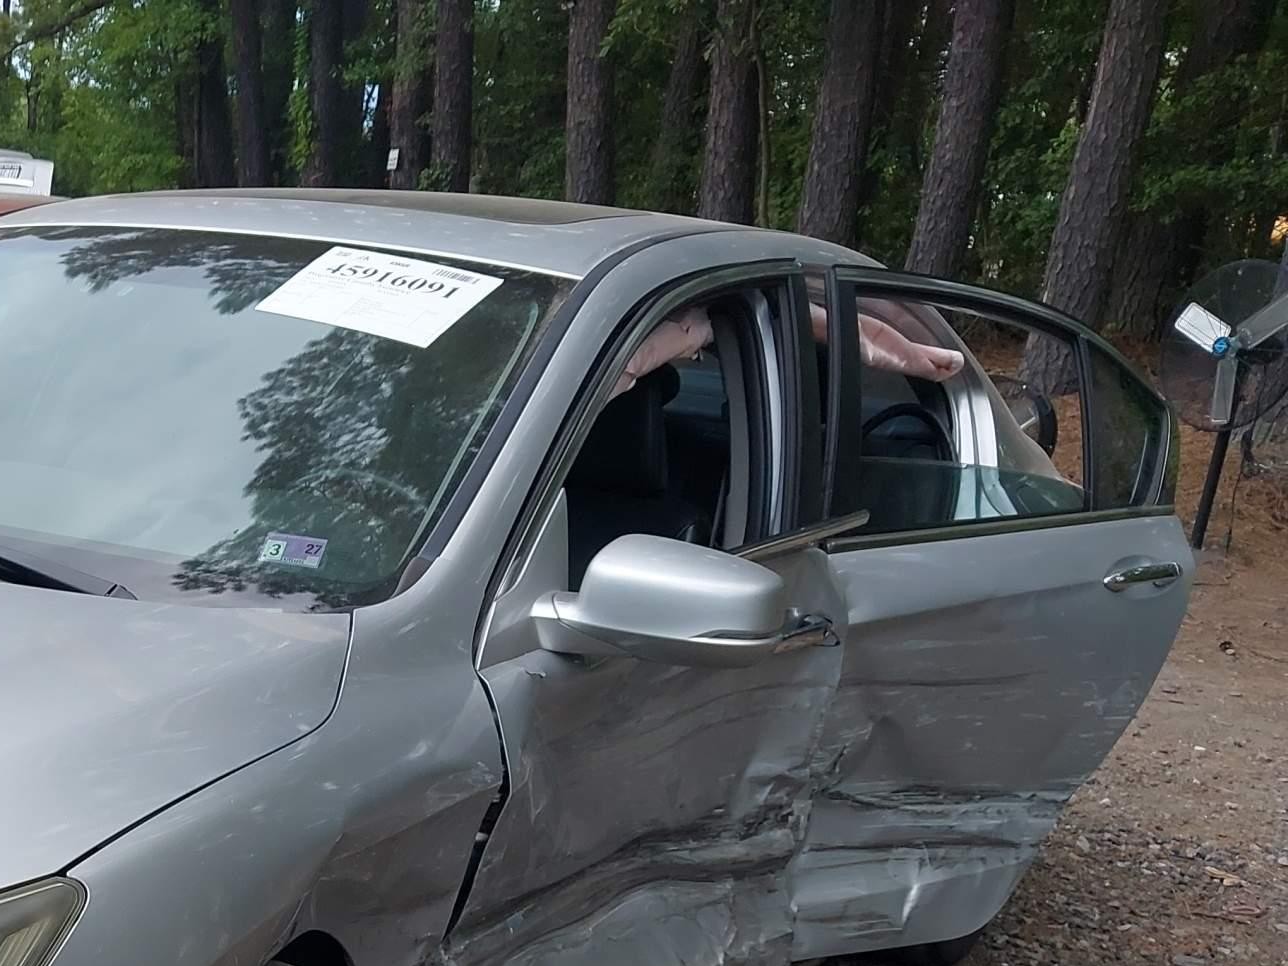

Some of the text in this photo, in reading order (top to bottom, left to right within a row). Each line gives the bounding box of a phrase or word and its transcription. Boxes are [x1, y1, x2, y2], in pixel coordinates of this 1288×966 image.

[326, 263, 461, 299] 45916091
[269, 543, 323, 556] 3 27
